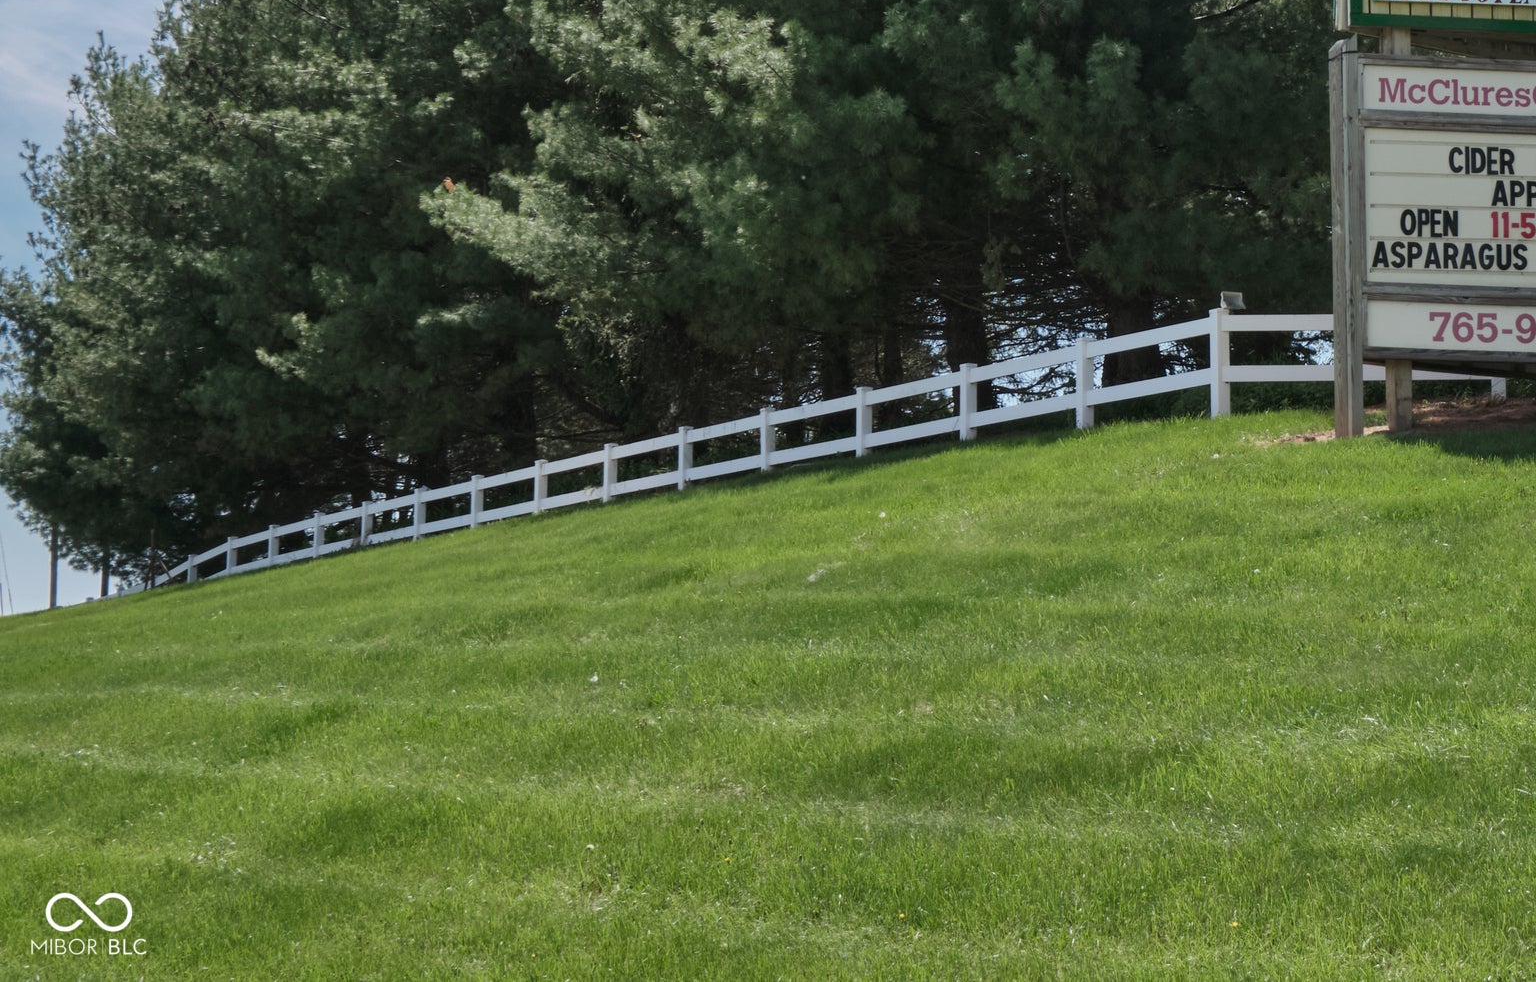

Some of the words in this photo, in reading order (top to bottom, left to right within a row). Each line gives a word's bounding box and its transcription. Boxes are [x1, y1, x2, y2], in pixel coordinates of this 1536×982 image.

[1448, 145, 1515, 176] CIDER
[1400, 208, 1459, 238] OPEN
[1490, 211, 1536, 240] 11-5
[1371, 241, 1528, 272] ASPARAGUS
